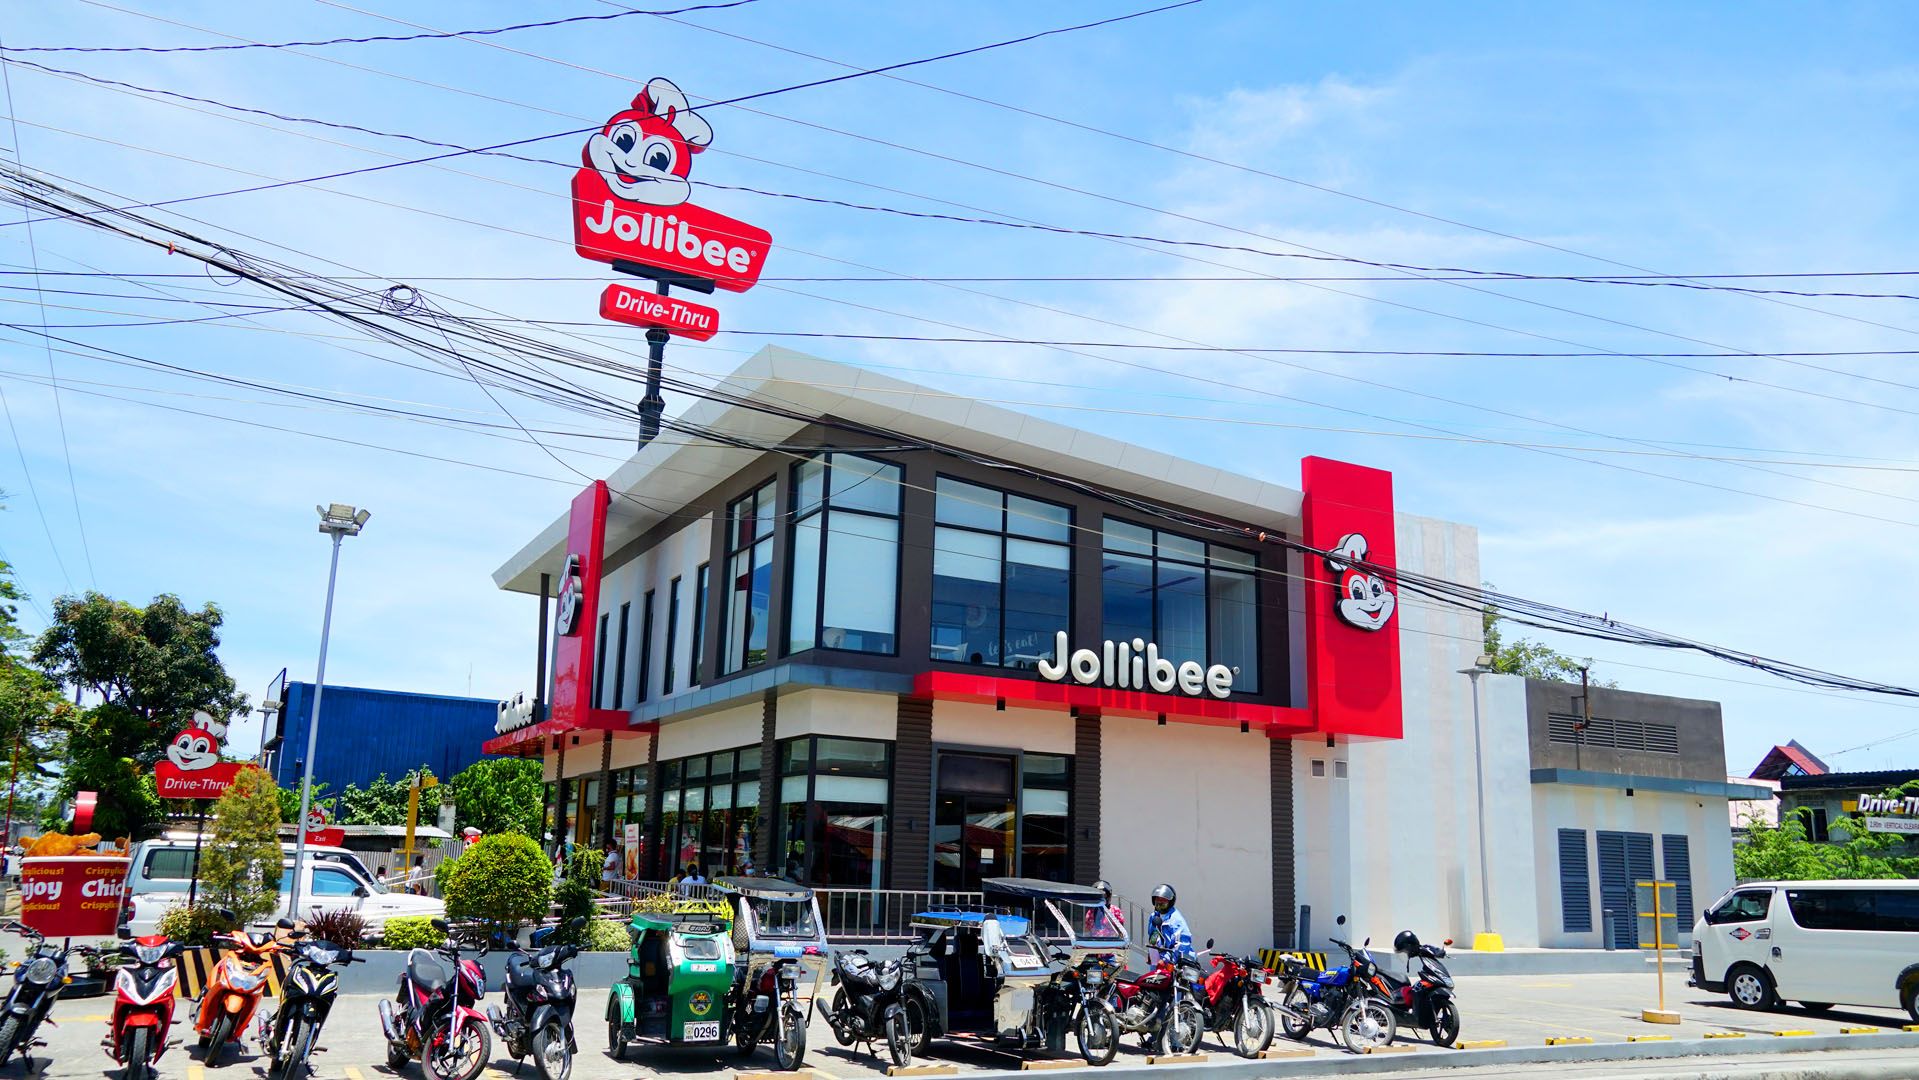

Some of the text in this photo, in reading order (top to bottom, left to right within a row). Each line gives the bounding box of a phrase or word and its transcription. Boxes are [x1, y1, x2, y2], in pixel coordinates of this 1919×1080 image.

[585, 199, 750, 273] Jollibee
[615, 291, 710, 329] Drive-Thru
[1038, 631, 1233, 699] Jollibee
[164, 778, 229, 790] Drive-Thru
[693, 1026, 718, 1038] 0296
